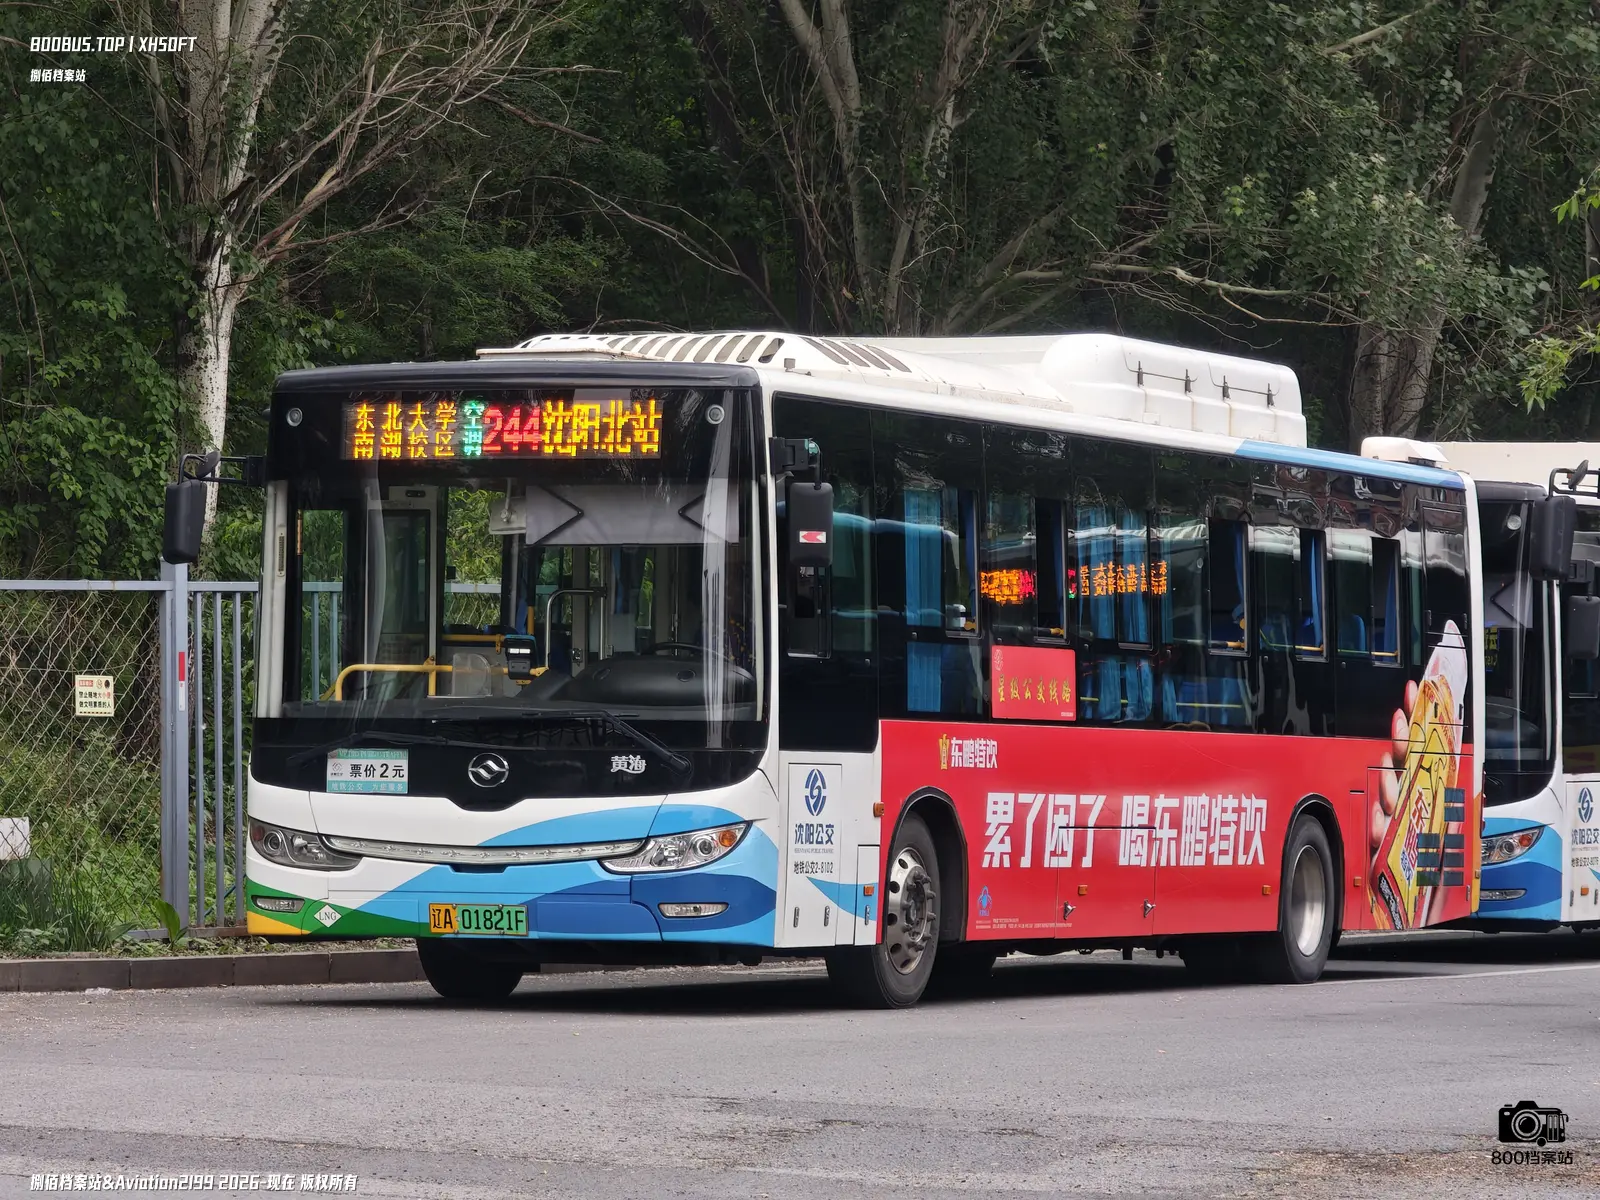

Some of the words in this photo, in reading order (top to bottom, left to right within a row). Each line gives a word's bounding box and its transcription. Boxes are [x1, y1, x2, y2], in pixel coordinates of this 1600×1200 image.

[354, 401, 457, 431] 东北大学
[483, 407, 543, 452] 244
[542, 400, 662, 457] 沈阳北站
[353, 431, 456, 459] 南湖校区
[611, 754, 647, 774] 黄海
[950, 736, 998, 769] 东鹏特饮
[795, 823, 834, 845] 沈阳公交
[981, 793, 1107, 868] 累了困了
[1118, 793, 1268, 868] 喝东鹏特饮
[1571, 828, 1599, 845] 沈阳公交
[318, 911, 337, 922] LNG
